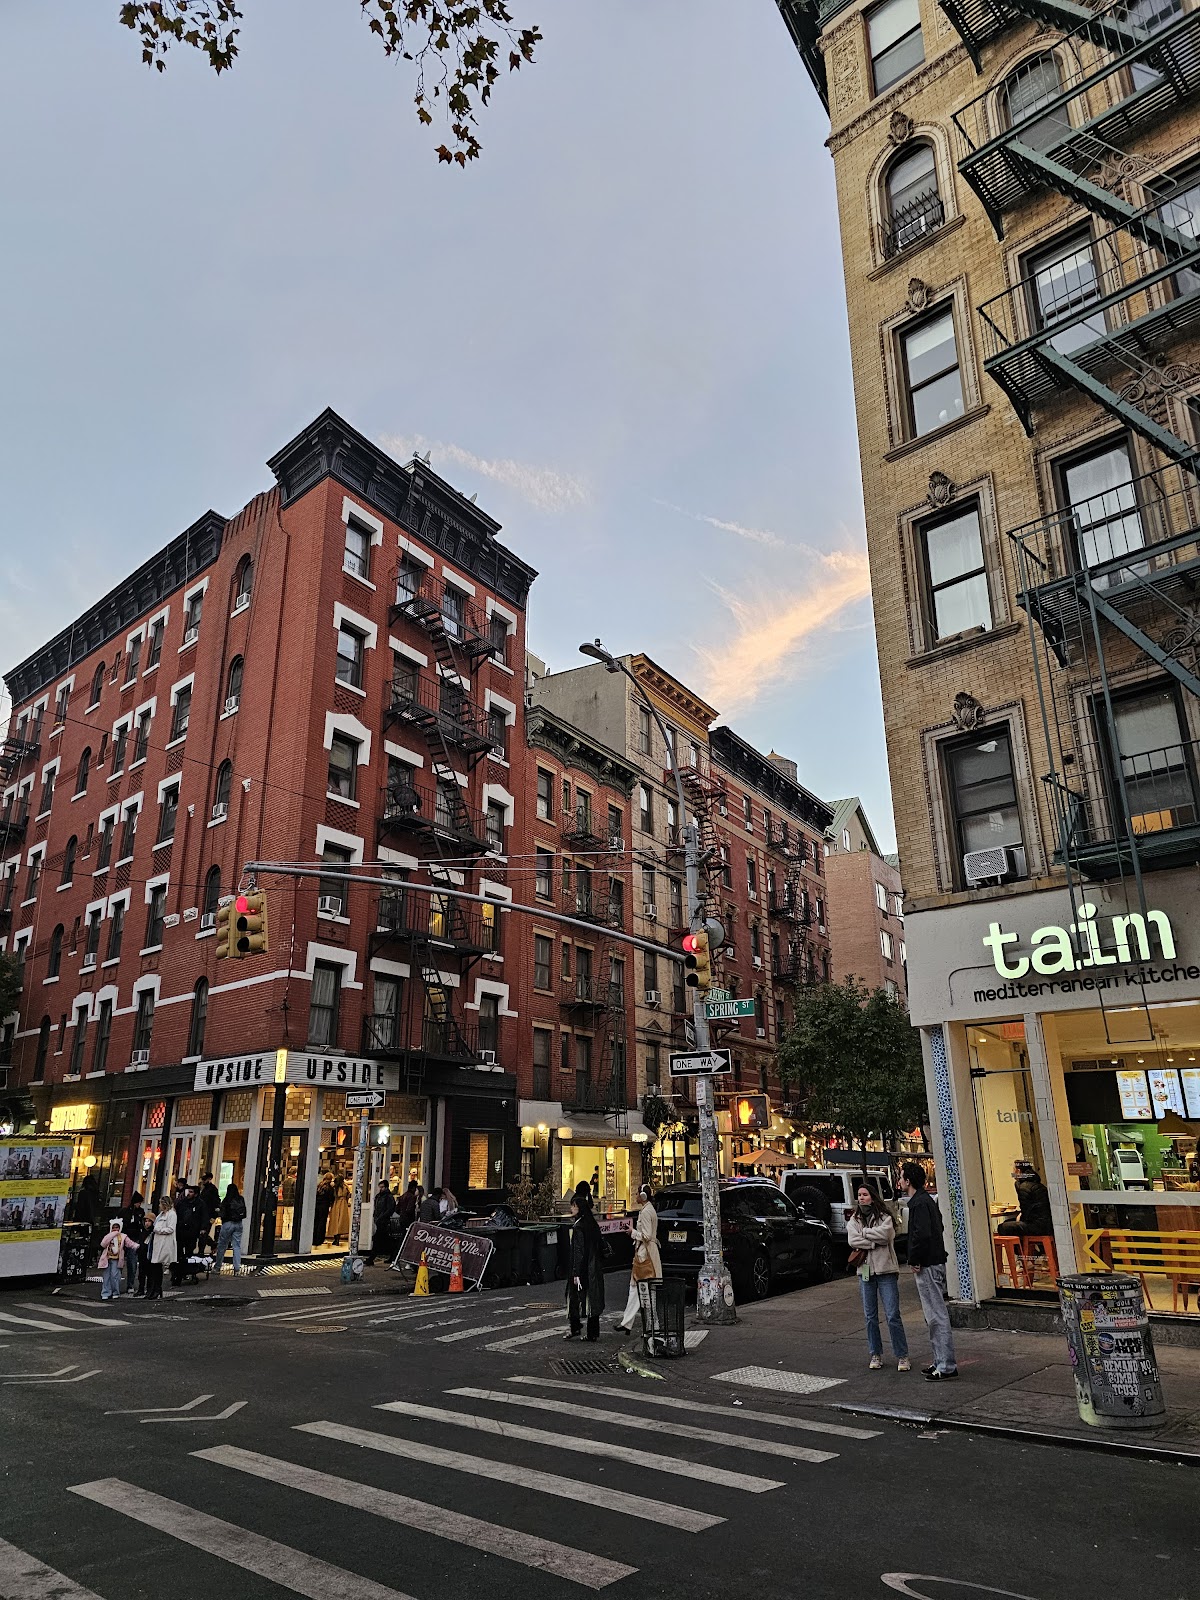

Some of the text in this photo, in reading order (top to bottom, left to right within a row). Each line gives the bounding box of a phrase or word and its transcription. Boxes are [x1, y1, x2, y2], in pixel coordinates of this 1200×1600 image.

[973, 977, 1120, 1003] mediterranean
[709, 1000, 750, 1017] SPRING ST
[205, 1058, 263, 1085] UPSIDE
[277, 1053, 285, 1080] PIZZA
[306, 1058, 385, 1085] UPSIDE
[676, 1058, 718, 1069] ONE WAY
[349, 1095, 378, 1104] ONE WAY
[413, 1229, 444, 1247] Don't
[424, 1247, 458, 1262] UPSID
[427, 1256, 452, 1268] PIZZA
